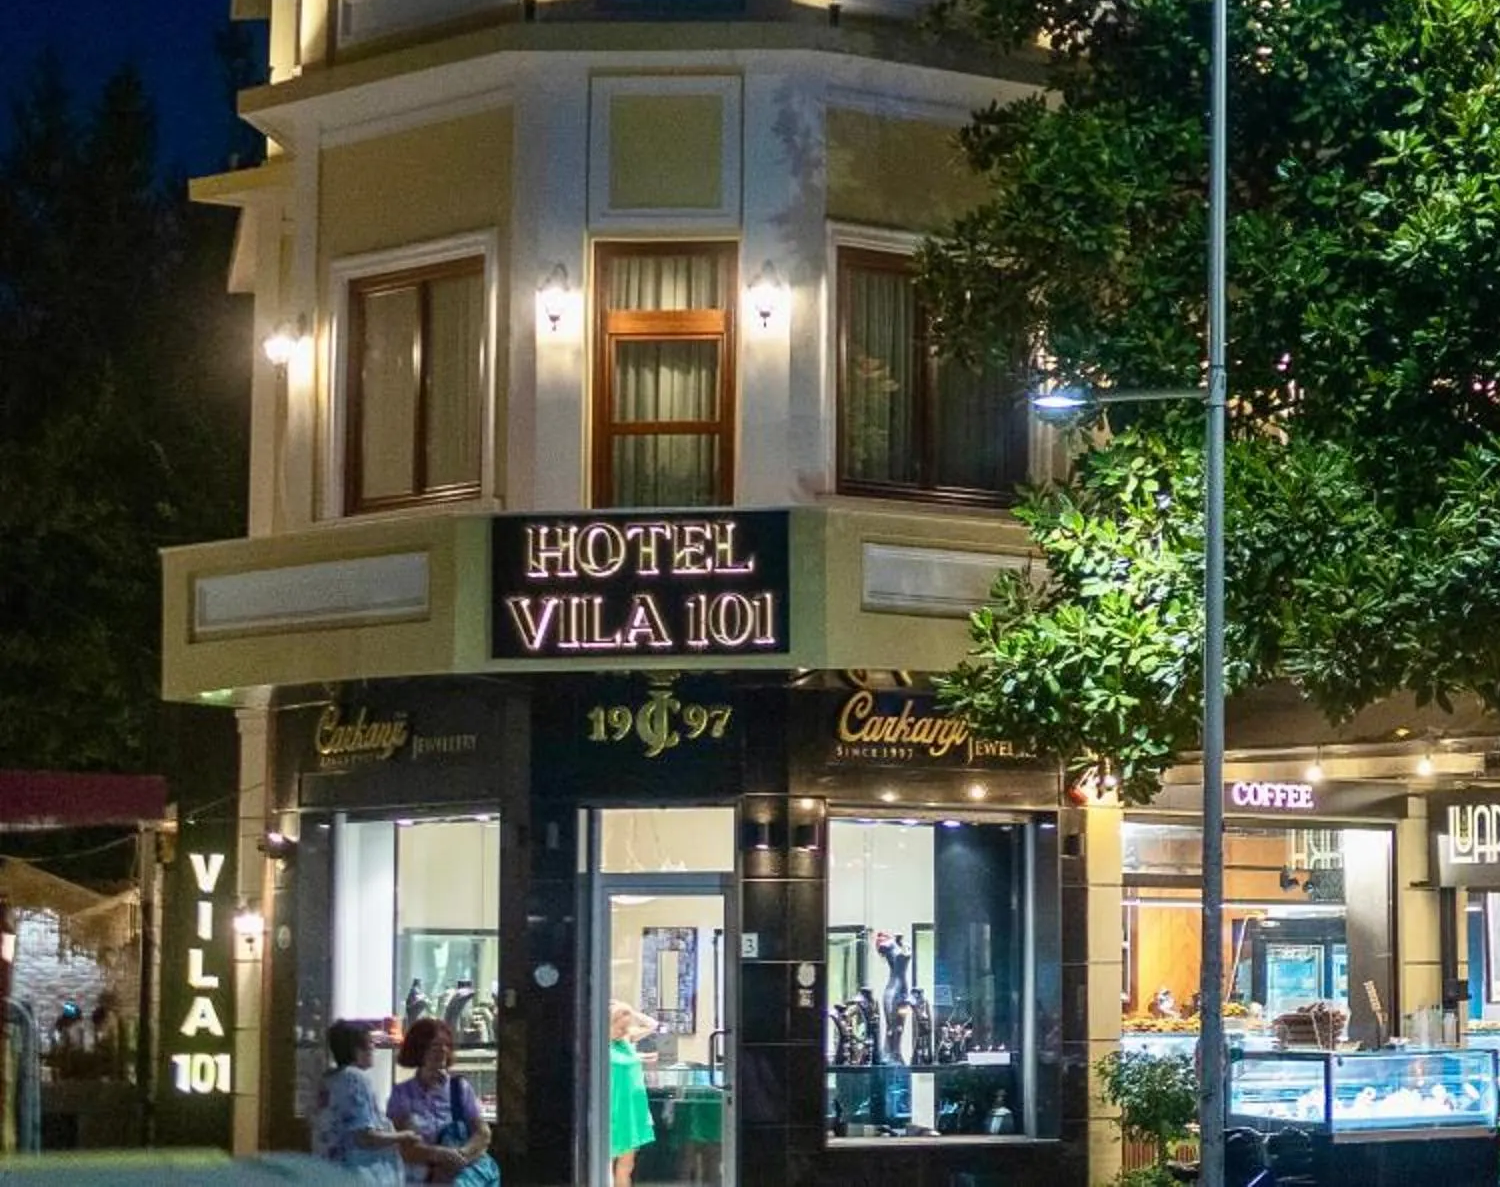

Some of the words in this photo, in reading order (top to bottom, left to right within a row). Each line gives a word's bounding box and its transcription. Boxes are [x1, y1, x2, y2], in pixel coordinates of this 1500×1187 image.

[526, 522, 754, 578] HOTEL
[506, 594, 673, 650] VILA
[687, 592, 776, 646] 101
[587, 706, 633, 741] 19
[683, 705, 733, 739] 97
[968, 736, 1037, 765] JEWEL
[1232, 782, 1314, 808] COFFEE
[180, 853, 225, 1037] VILA
[744, 938, 756, 954] 3
[171, 1053, 231, 1094] 101
